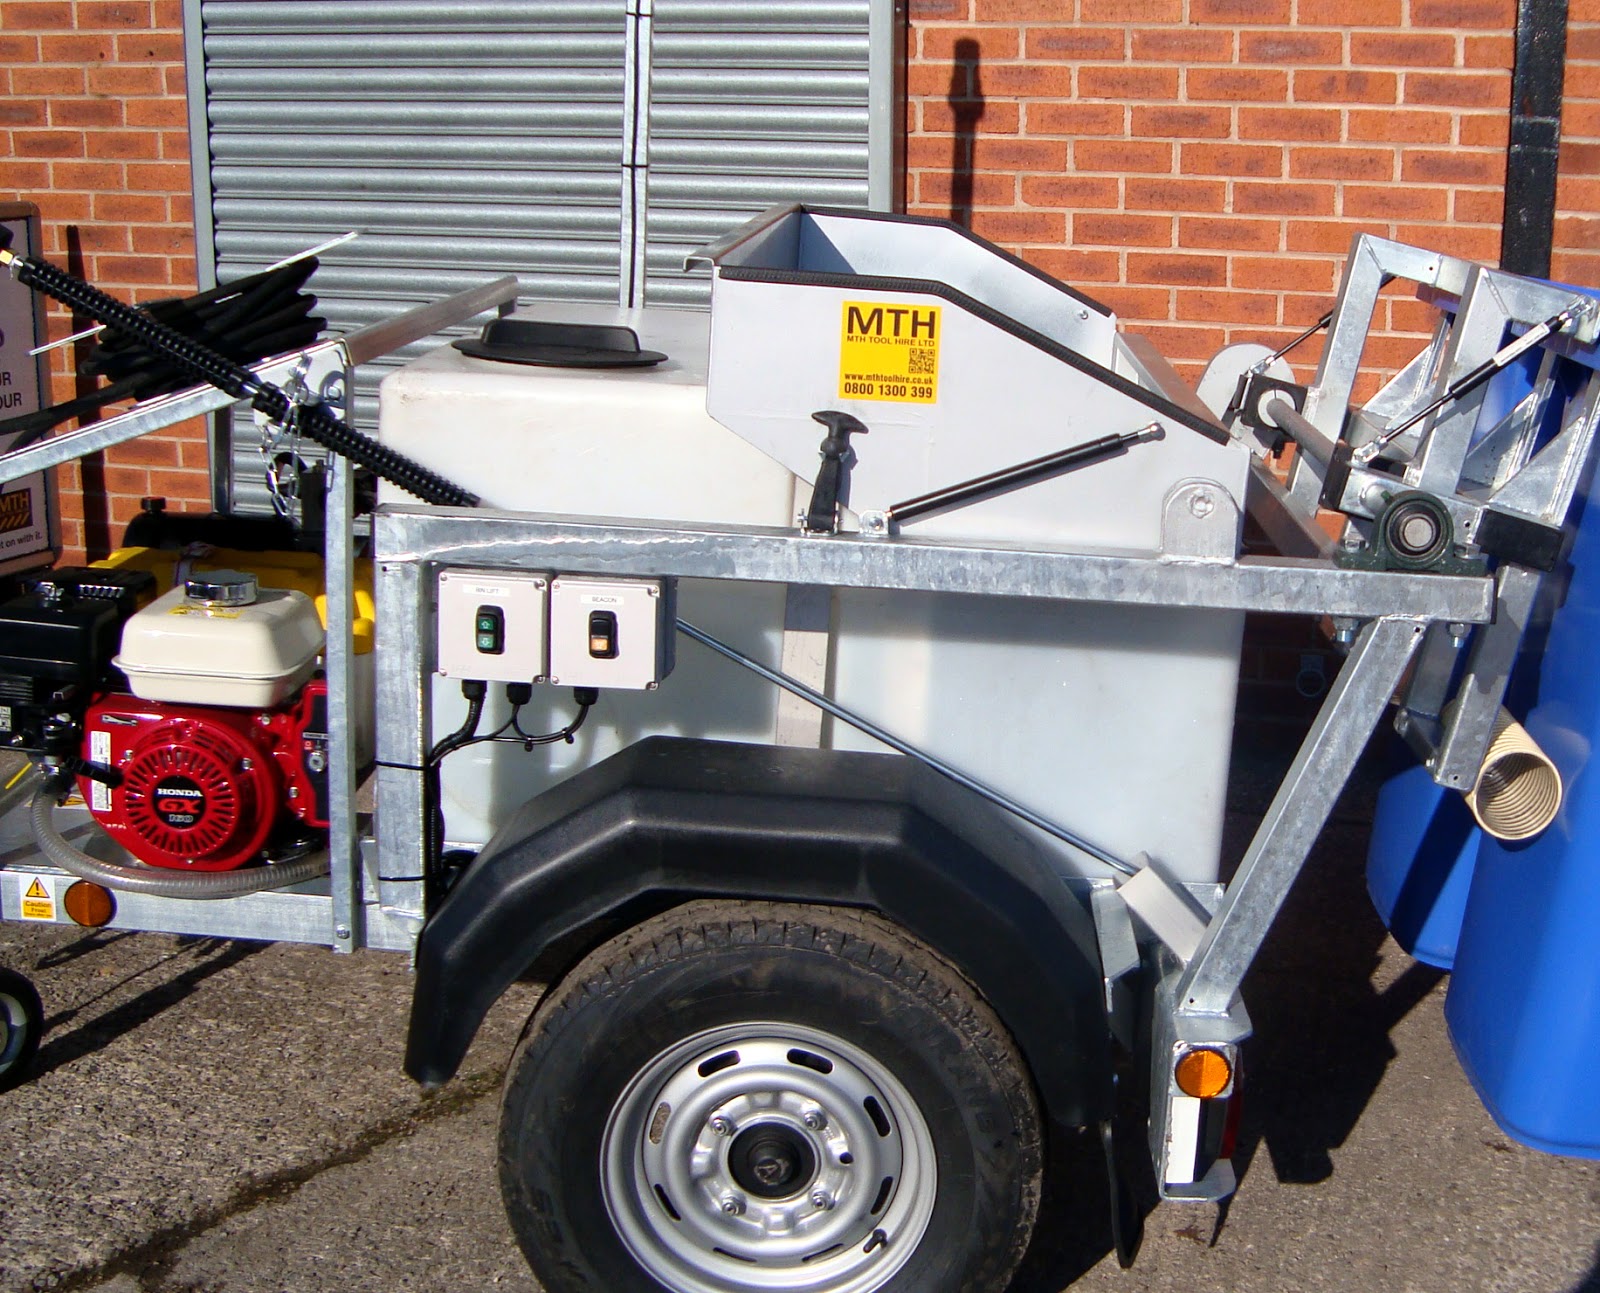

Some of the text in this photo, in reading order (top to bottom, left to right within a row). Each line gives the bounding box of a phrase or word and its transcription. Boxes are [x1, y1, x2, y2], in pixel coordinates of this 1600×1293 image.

[847, 306, 936, 339] MTH
[847, 335, 866, 343] MTH
[869, 336, 892, 345] TOOL
[895, 338, 916, 346] HIRE
[845, 373, 934, 385] www.mthtoolhire.co.uk
[844, 382, 933, 398] 0800 1300 399
[157, 787, 204, 797] HONDA
[158, 798, 200, 814] GX
